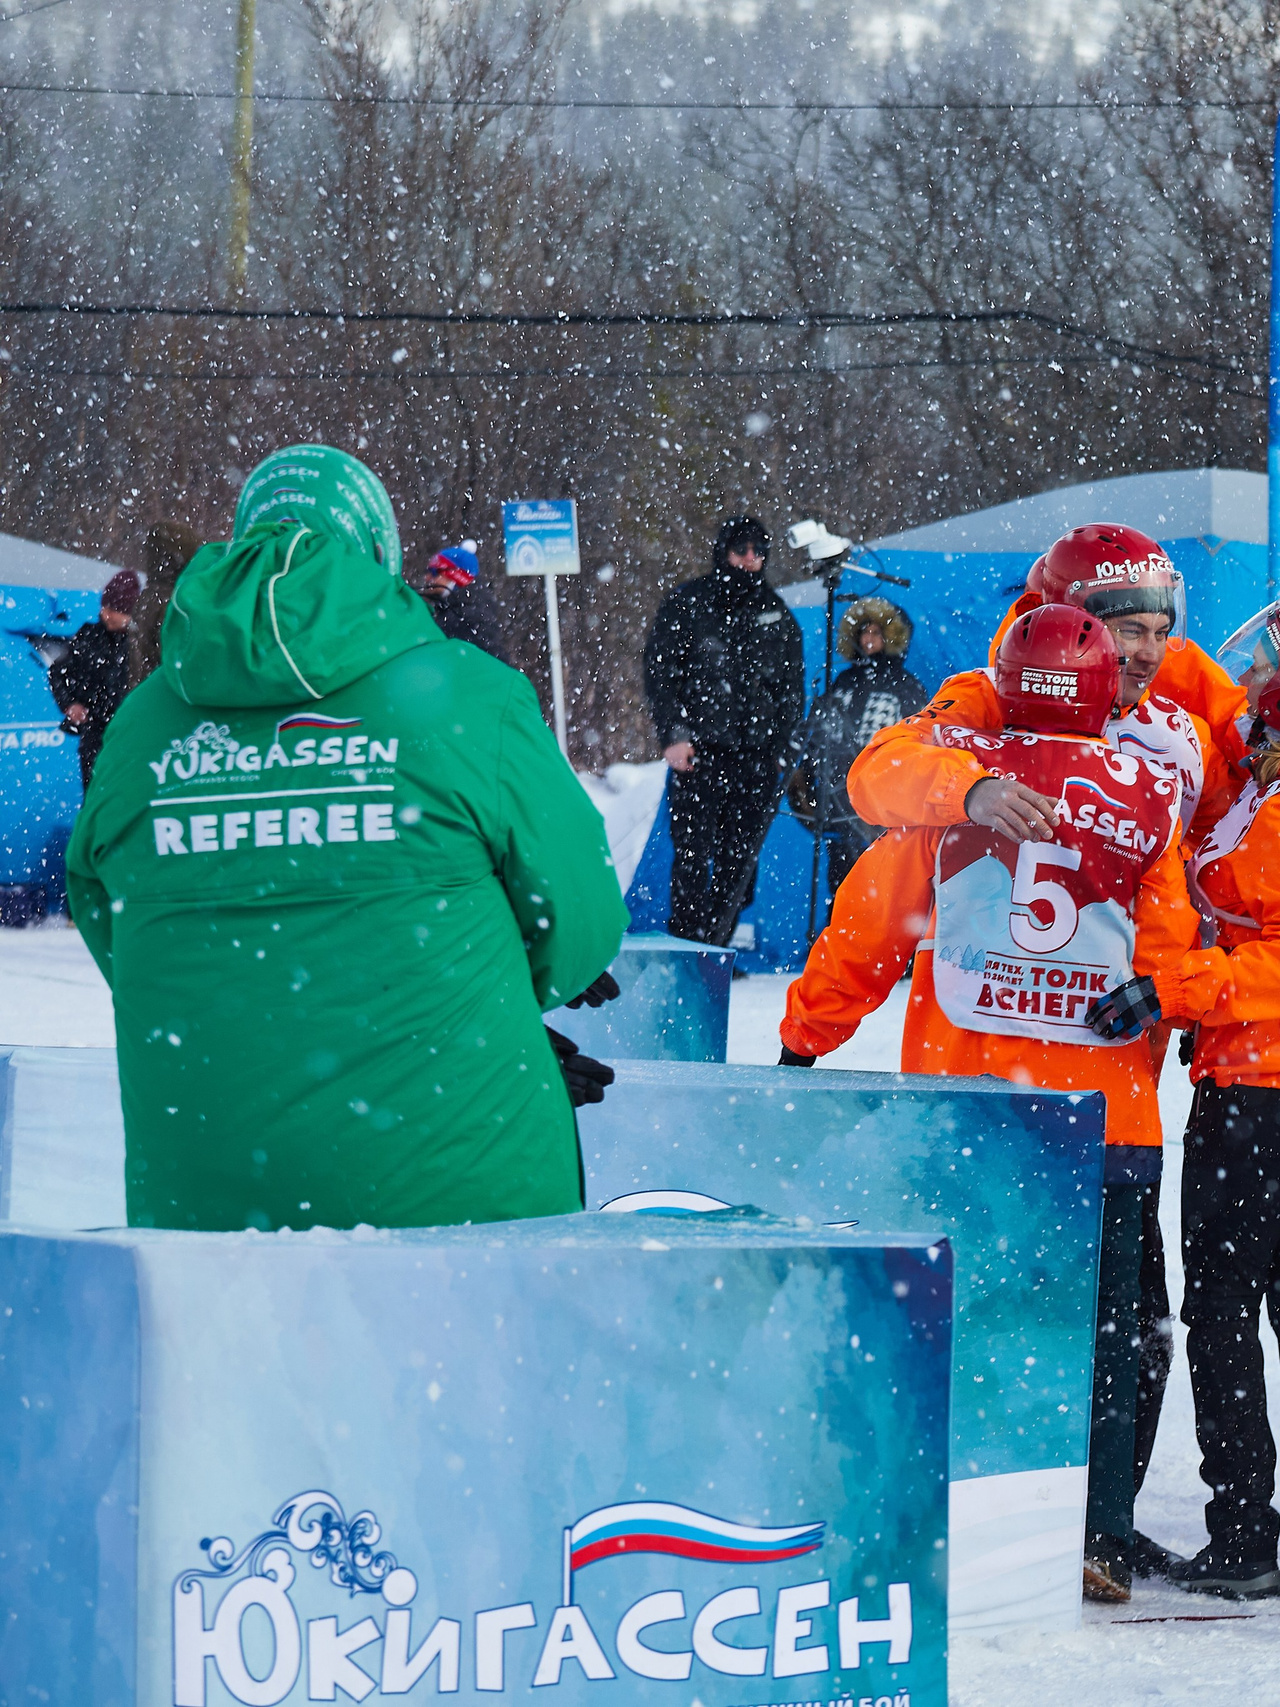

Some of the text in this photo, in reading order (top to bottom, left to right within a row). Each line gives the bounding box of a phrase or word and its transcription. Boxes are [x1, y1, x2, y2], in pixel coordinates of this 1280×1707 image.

[1095, 559, 1174, 578] ЮКИГАСС
[1021, 681, 1078, 697] В СНЕГЕ
[1045, 674, 1078, 685] ТОЛК
[148, 735, 399, 785] YUKIGASSEN
[153, 803, 397, 856] REFEREE
[1053, 799, 1158, 855] ASSEN
[1009, 840, 1083, 954] 5
[1030, 967, 1109, 993] ТОЛК
